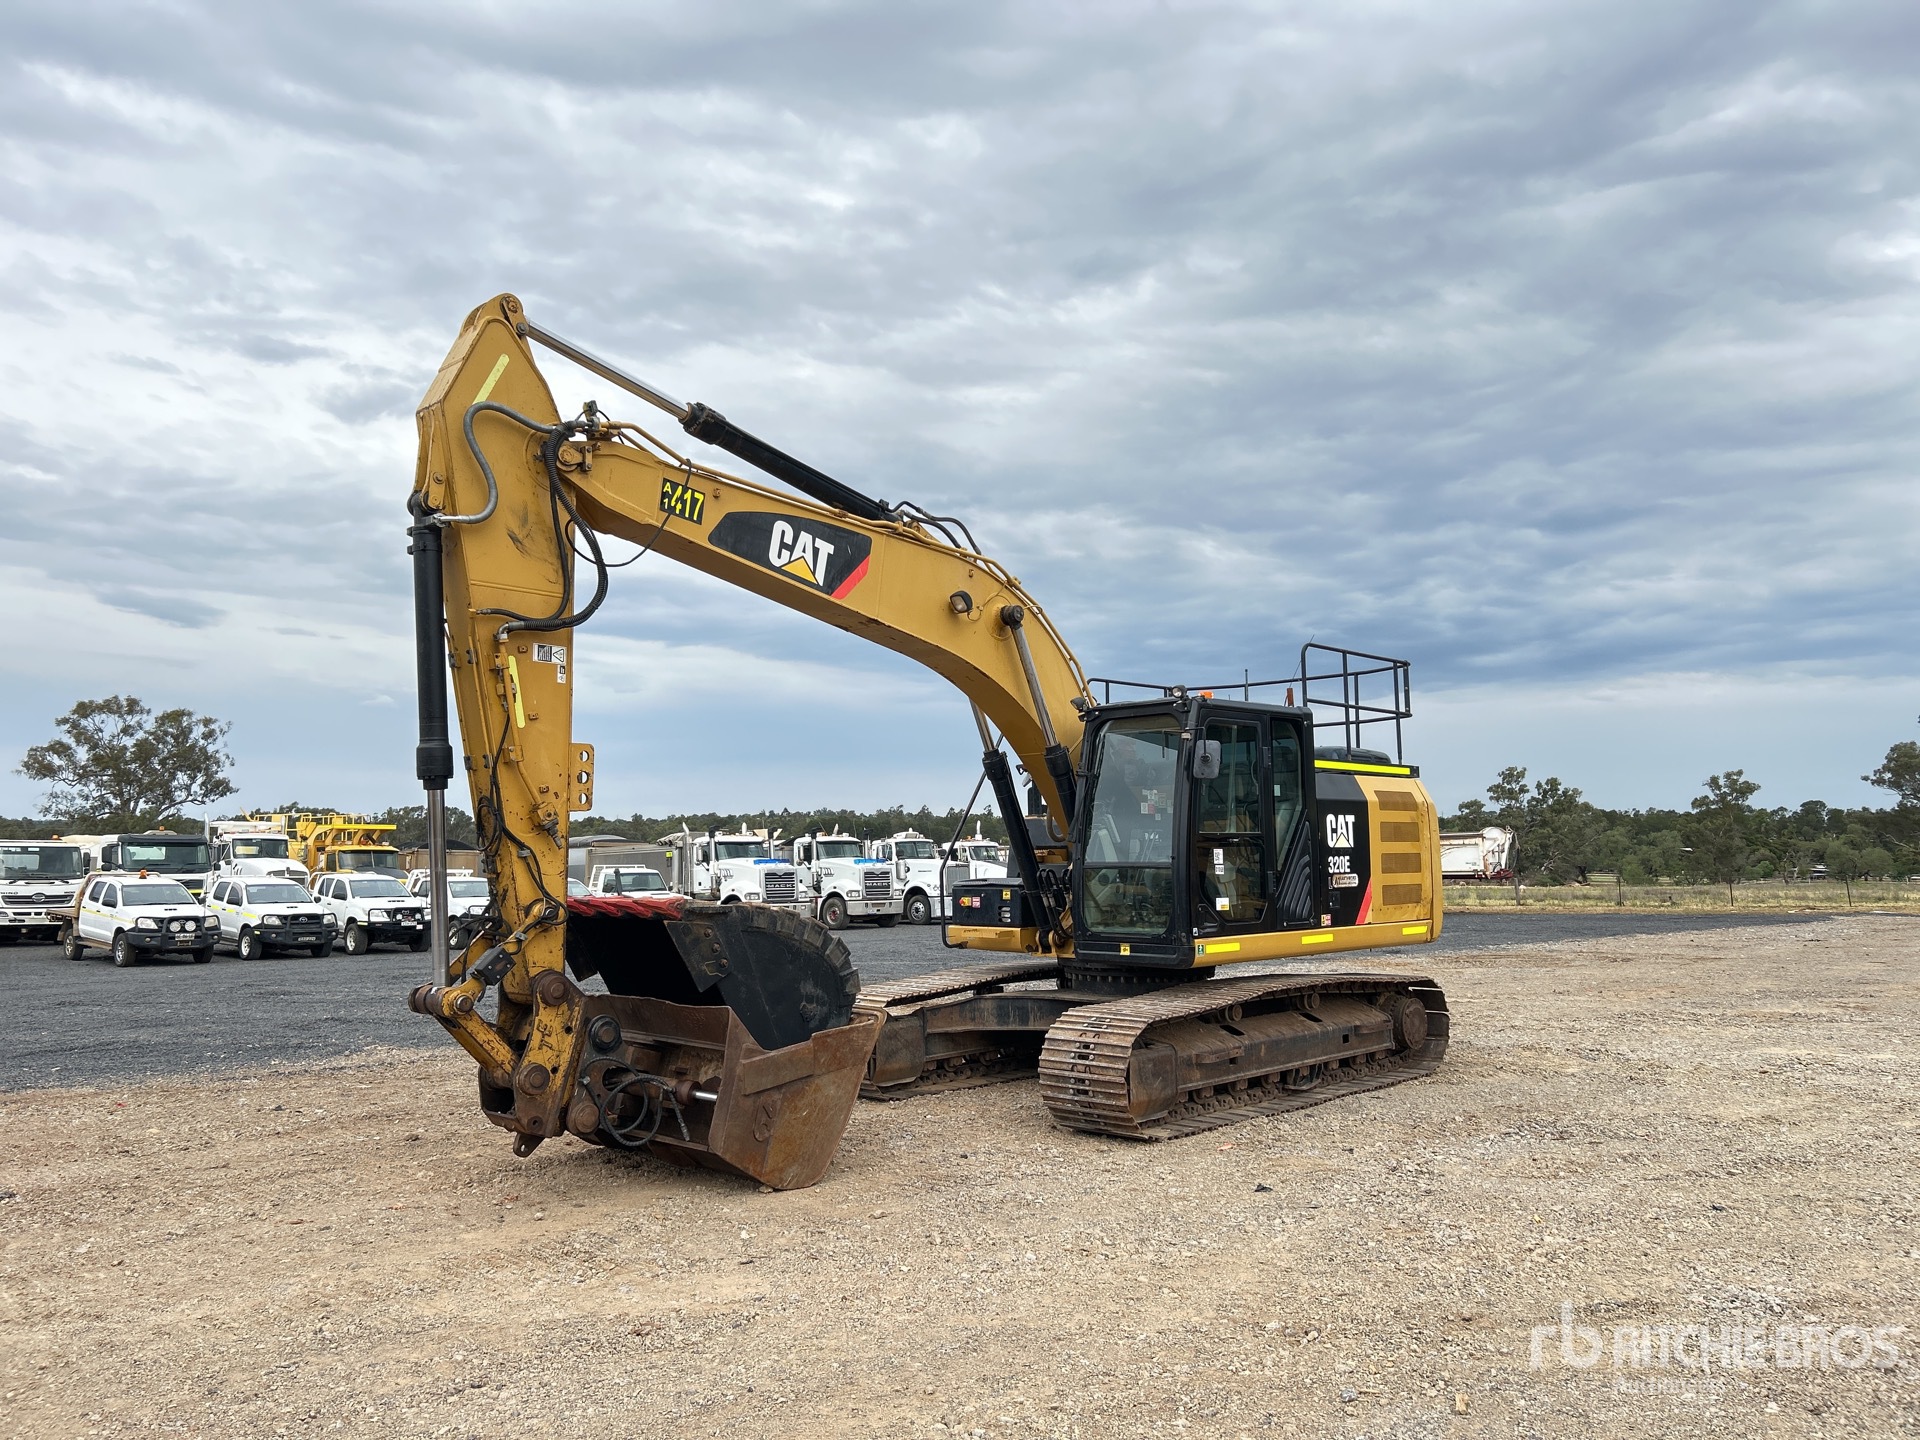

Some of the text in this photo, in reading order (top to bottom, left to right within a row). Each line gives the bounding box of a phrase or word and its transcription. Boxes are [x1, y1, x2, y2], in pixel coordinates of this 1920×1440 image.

[663, 482, 672, 495] A
[671, 485, 704, 521] 417
[768, 520, 835, 587] CAT
[1326, 813, 1355, 848] CAT
[1328, 855, 1350, 873] 320E
